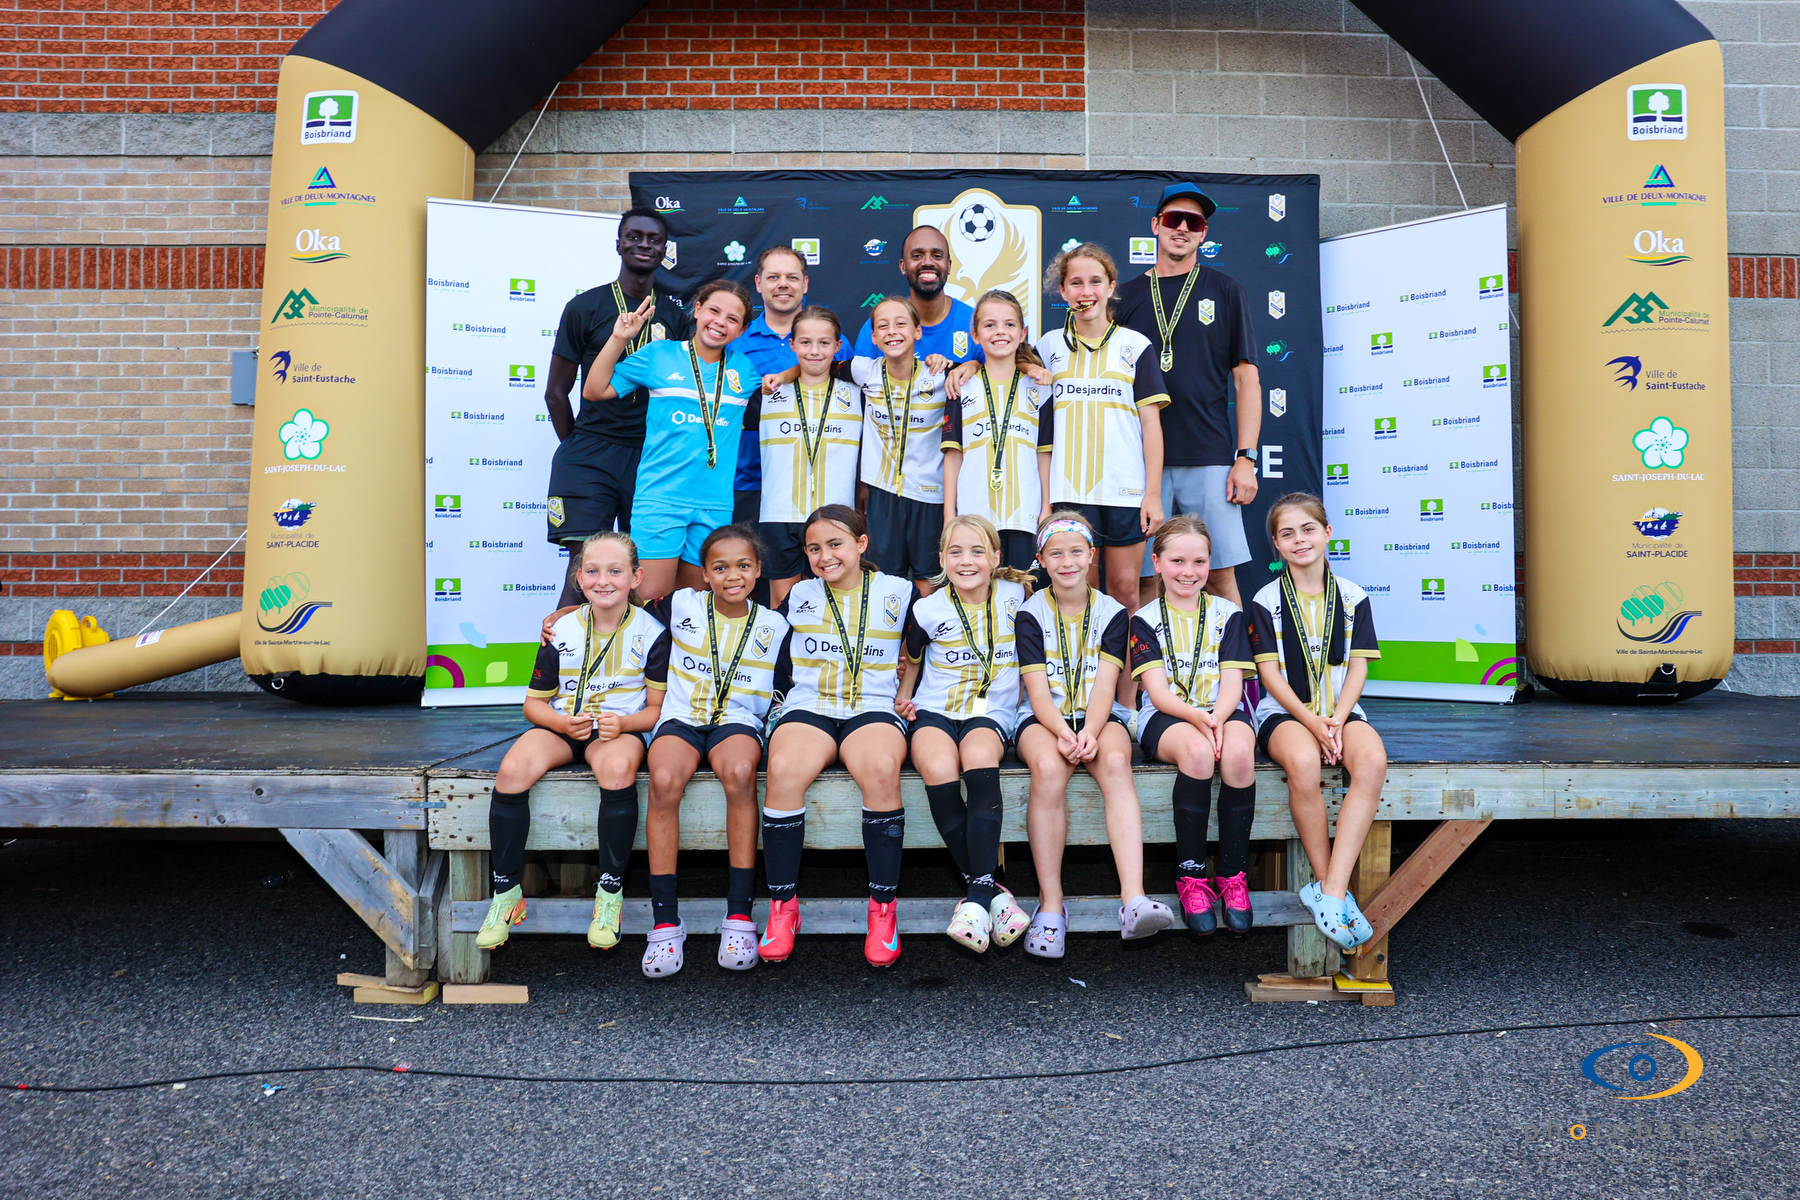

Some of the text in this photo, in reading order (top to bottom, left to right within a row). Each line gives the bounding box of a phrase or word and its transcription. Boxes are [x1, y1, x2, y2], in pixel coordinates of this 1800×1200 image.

[304, 129, 351, 140] Boisbriand
[1633, 125, 1683, 135] Boisbriand
[281, 196, 294, 206] VILLE
[304, 193, 376, 203] DEUX-MONTAGNES
[655, 196, 681, 209] Oka
[1602, 192, 1707, 203] VILLE DE DEUX-MONTAGNES
[295, 228, 342, 252] Oka
[1634, 230, 1685, 254] Oka
[428, 278, 470, 288] Boisbriand
[1411, 289, 1446, 300] Boisbriand
[309, 304, 356, 314] Municipalité
[1337, 301, 1370, 312] Boisbriand
[308, 311, 368, 321] Pointe-Calumet
[1658, 309, 1701, 319] Municipalité
[1658, 316, 1710, 326] Pointe-Calumet
[466, 324, 506, 333] Boisbriand
[1439, 327, 1477, 338] Boisbriand
[1323, 345, 1343, 353] briand
[293, 363, 322, 372] Ville de
[432, 367, 472, 376] Boisbriand
[293, 375, 355, 383] Saint-Eustache
[1646, 370, 1678, 379] Ville de
[1414, 376, 1449, 386] Boisbriand
[1646, 382, 1705, 390] Saint-Eustache
[1067, 385, 1121, 396] Desjardins
[1349, 383, 1383, 393] Boisbriand
[464, 412, 504, 420] Boisbriand
[1443, 416, 1480, 425] Boisbriand
[794, 423, 842, 434] Dsjadins
[1322, 428, 1345, 436] sbriand
[482, 458, 522, 466] Boisbriand
[1461, 460, 1498, 470] Boisbriand
[265, 464, 346, 474] SAINT-JOSEPH-DU-LAC
[1393, 464, 1428, 472] Boisbriand
[1613, 473, 1704, 482] SAINT-JOSEPH-DU-LAC
[515, 502, 547, 510] Boisbria
[267, 541, 319, 549] SAINT-PLACIDE
[1463, 541, 1500, 549] Boisbriand
[821, 641, 884, 657] Desadins
